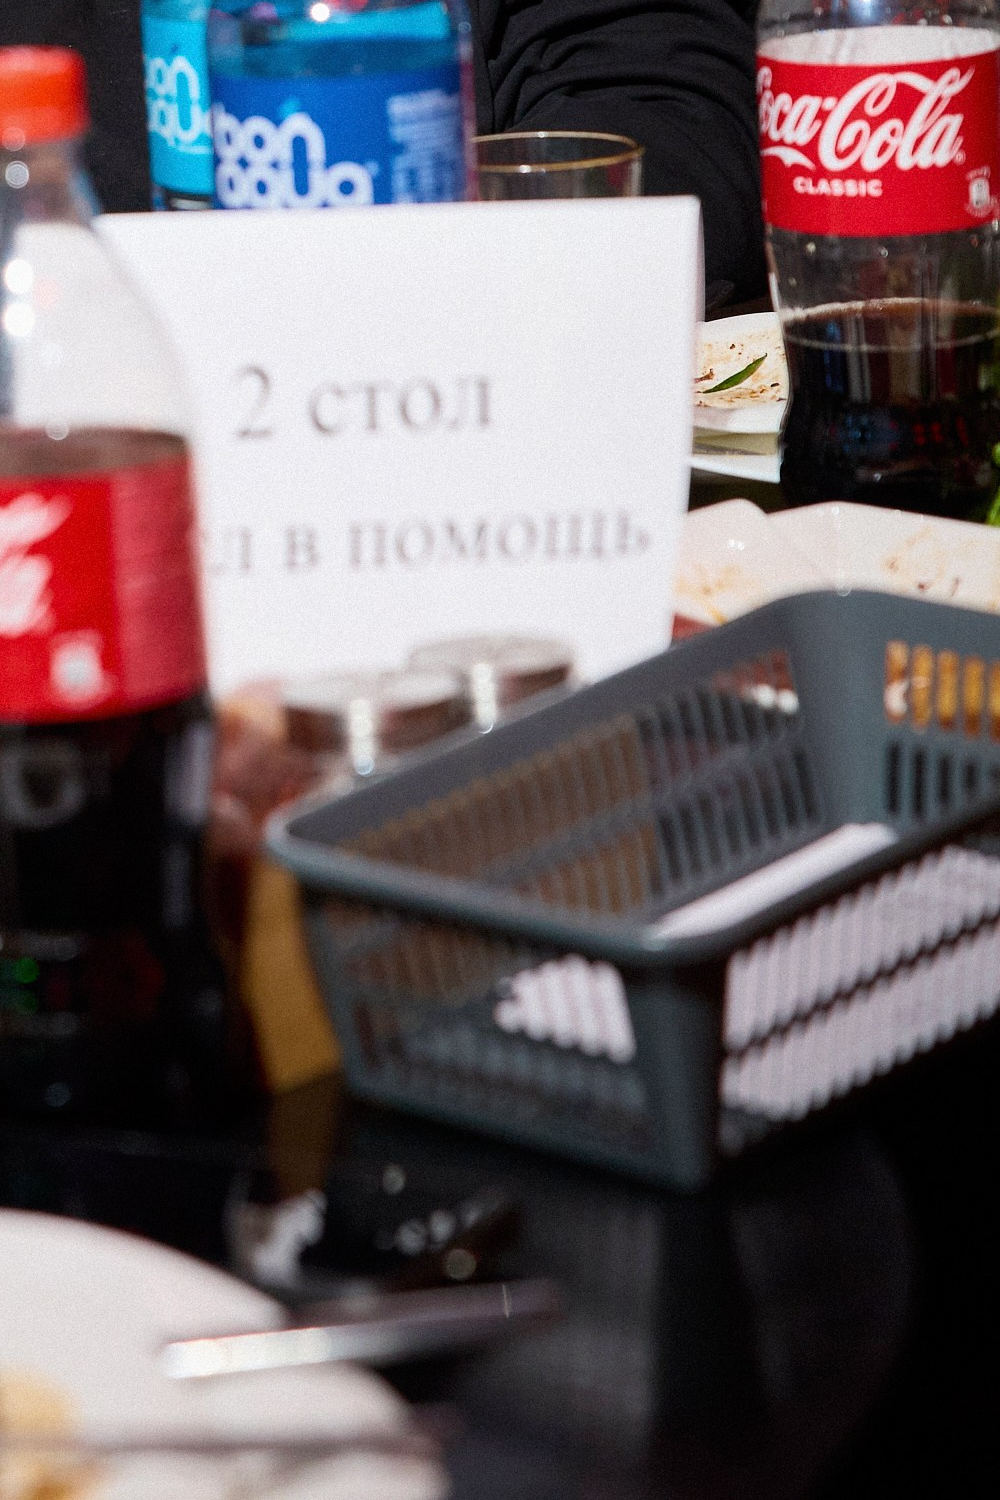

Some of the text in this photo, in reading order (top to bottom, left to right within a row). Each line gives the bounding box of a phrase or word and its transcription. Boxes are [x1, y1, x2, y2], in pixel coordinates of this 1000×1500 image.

[793, 176, 883, 198] CLASSIC
[234, 364, 494, 439] 2 стол
[346, 512, 653, 568] помощь
